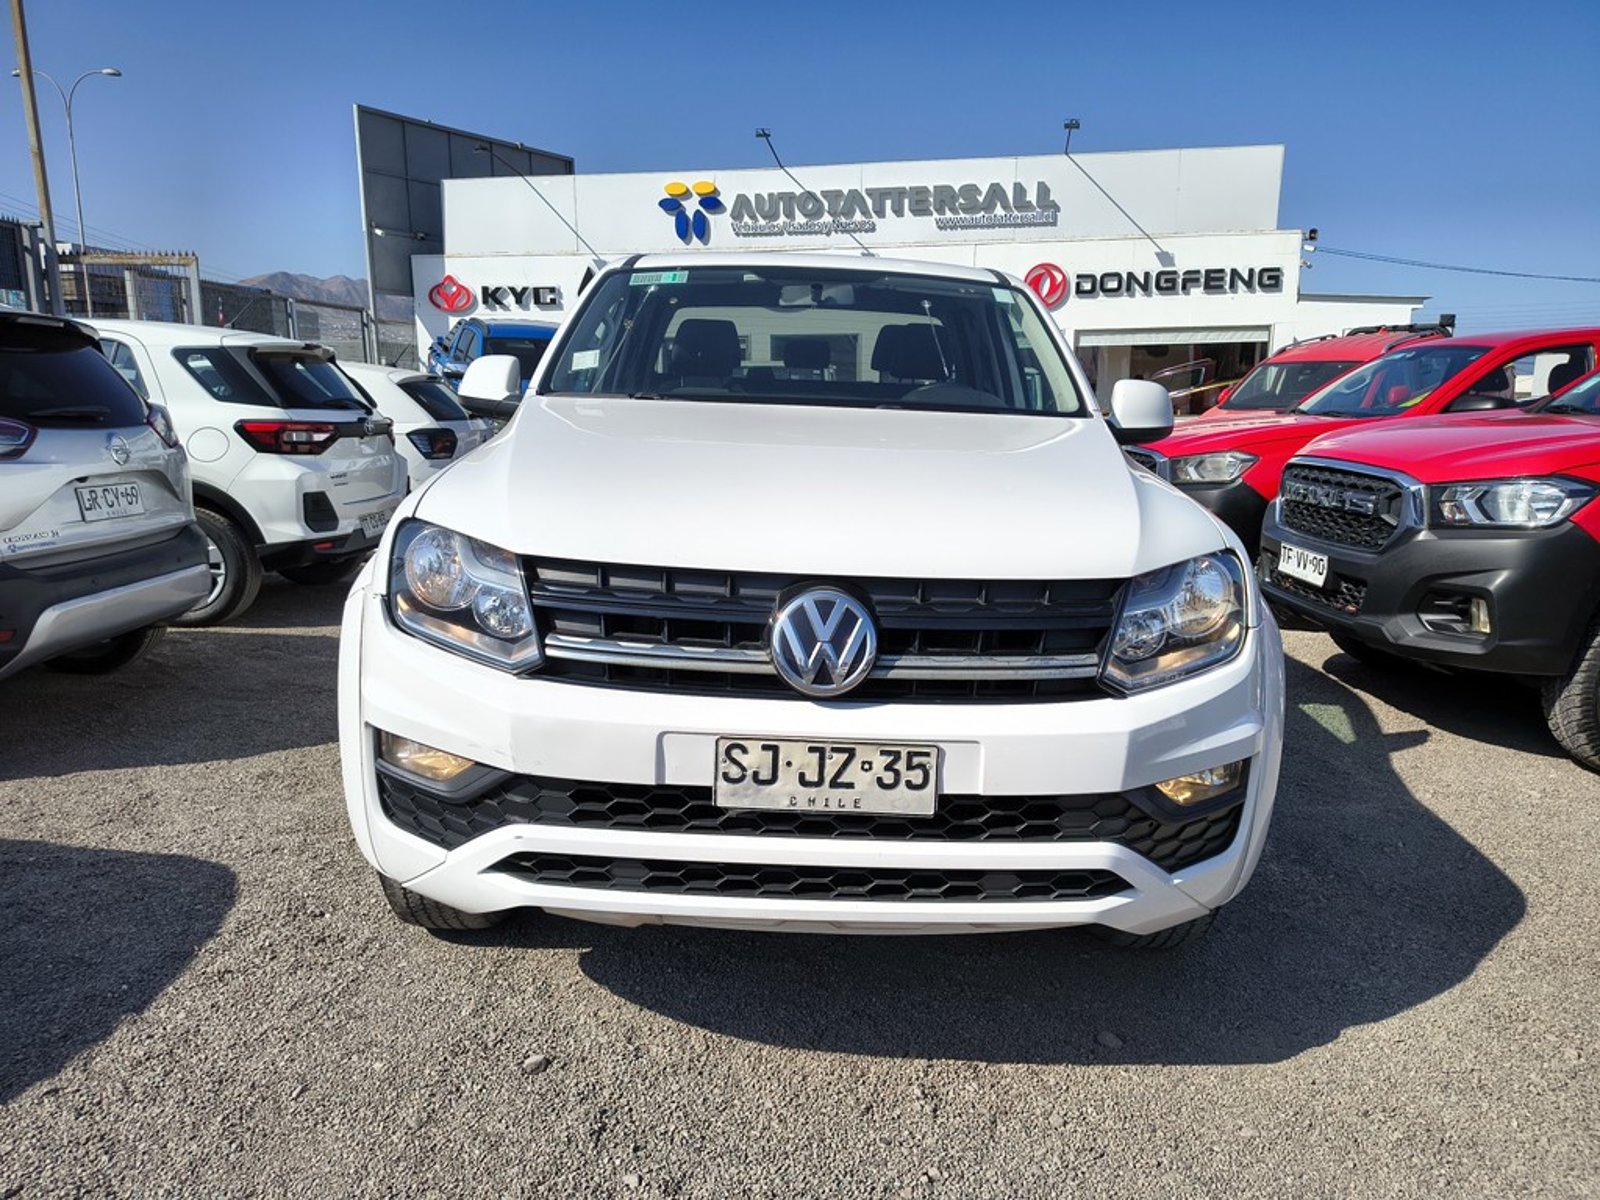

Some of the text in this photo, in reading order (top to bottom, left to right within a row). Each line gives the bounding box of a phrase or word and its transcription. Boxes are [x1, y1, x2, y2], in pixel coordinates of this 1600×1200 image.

[731, 182, 1060, 220] AUTOTATTERSALL
[1075, 267, 1282, 296] DONGFENG
[481, 285, 557, 305] KYC
[788, 796, 861, 808] CHILE
